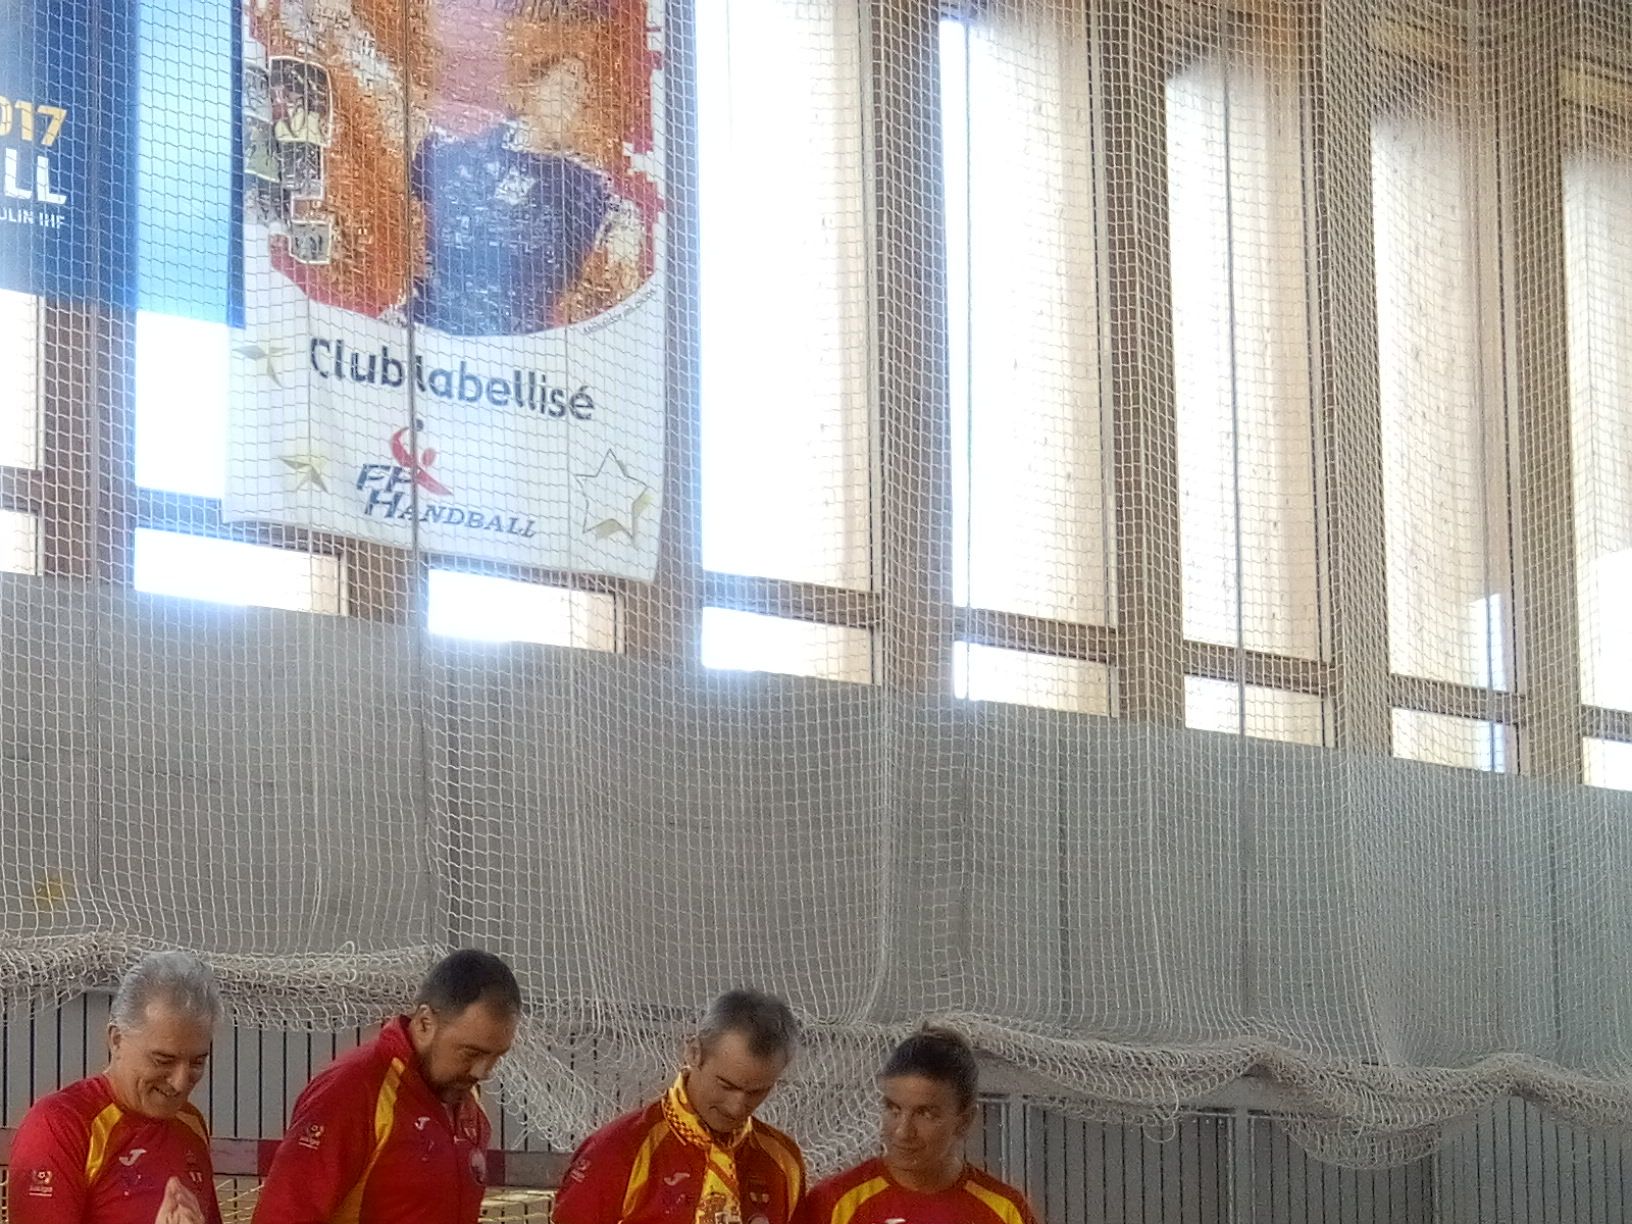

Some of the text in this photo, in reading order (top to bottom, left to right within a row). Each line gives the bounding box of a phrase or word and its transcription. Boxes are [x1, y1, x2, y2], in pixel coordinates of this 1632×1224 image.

[39, 212, 66, 229] IHF
[311, 337, 595, 421] Club labellisé
[364, 489, 538, 539] HANDBALL
